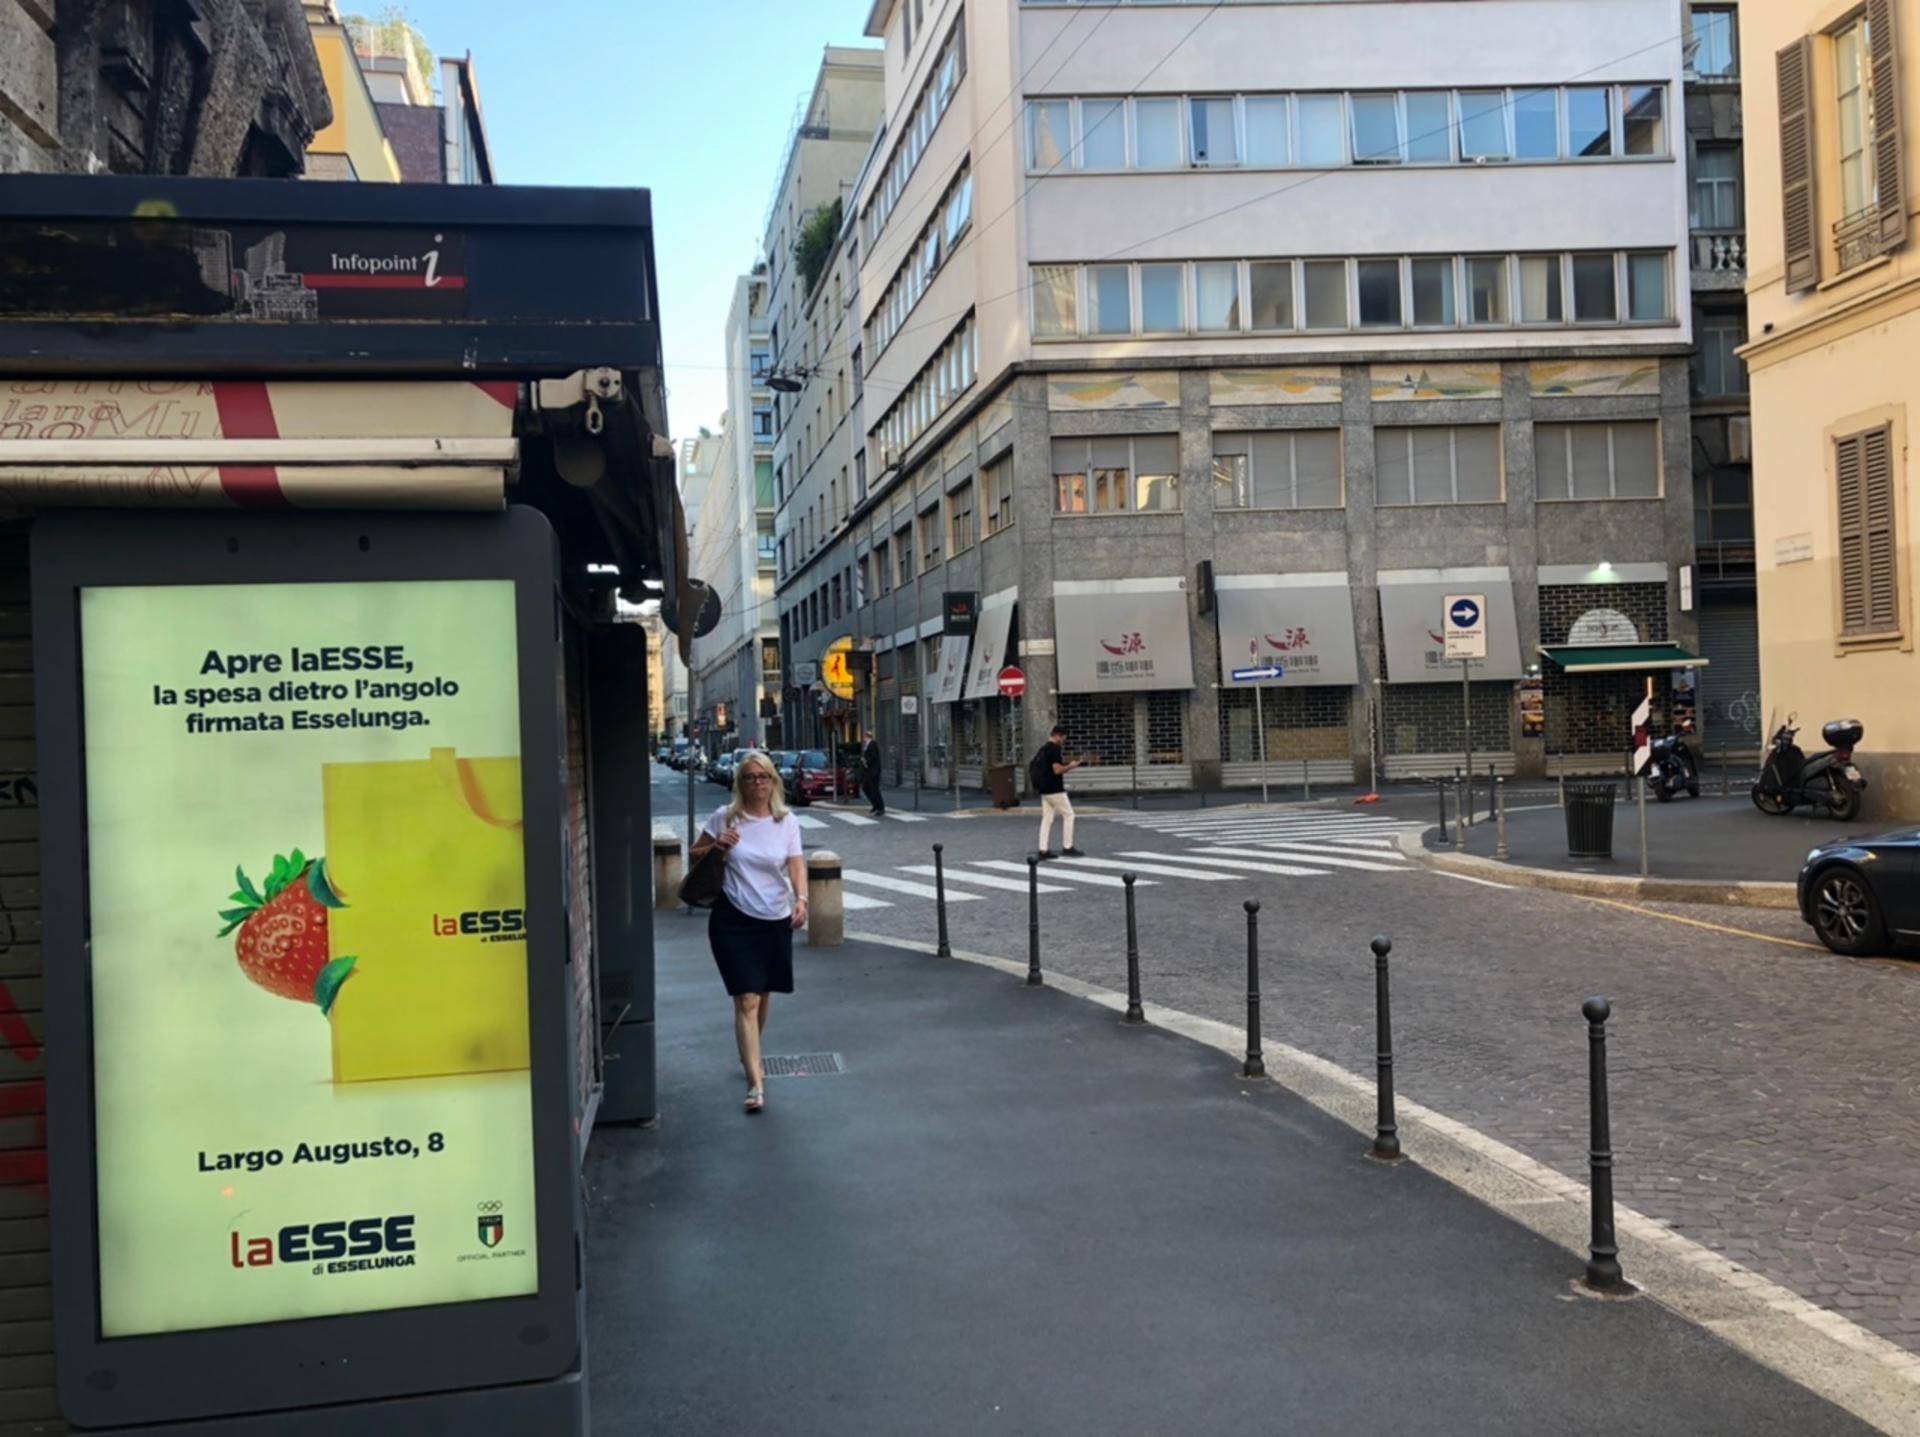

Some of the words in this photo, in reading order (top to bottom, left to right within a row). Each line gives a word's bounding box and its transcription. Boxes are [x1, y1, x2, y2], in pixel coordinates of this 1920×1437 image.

[330, 252, 417, 274] Infopoint
[200, 651, 282, 678] Apre
[291, 646, 414, 673] laESSE,
[153, 686, 177, 705] la
[185, 687, 261, 708] spesa
[269, 681, 348, 702] dietro
[356, 677, 459, 701] l’angolo
[186, 713, 284, 734] firmata
[291, 708, 430, 731] Esselunga.
[433, 909, 527, 936] laESS
[199, 1151, 283, 1172] Largo
[293, 1137, 419, 1164] Augusto,
[428, 1133, 444, 1153] 8
[231, 1217, 415, 1268] laESSE
[492, 1249, 526, 1258] PARTNER
[312, 1265, 324, 1276] di
[328, 1255, 415, 1274] ESSELUNGA
